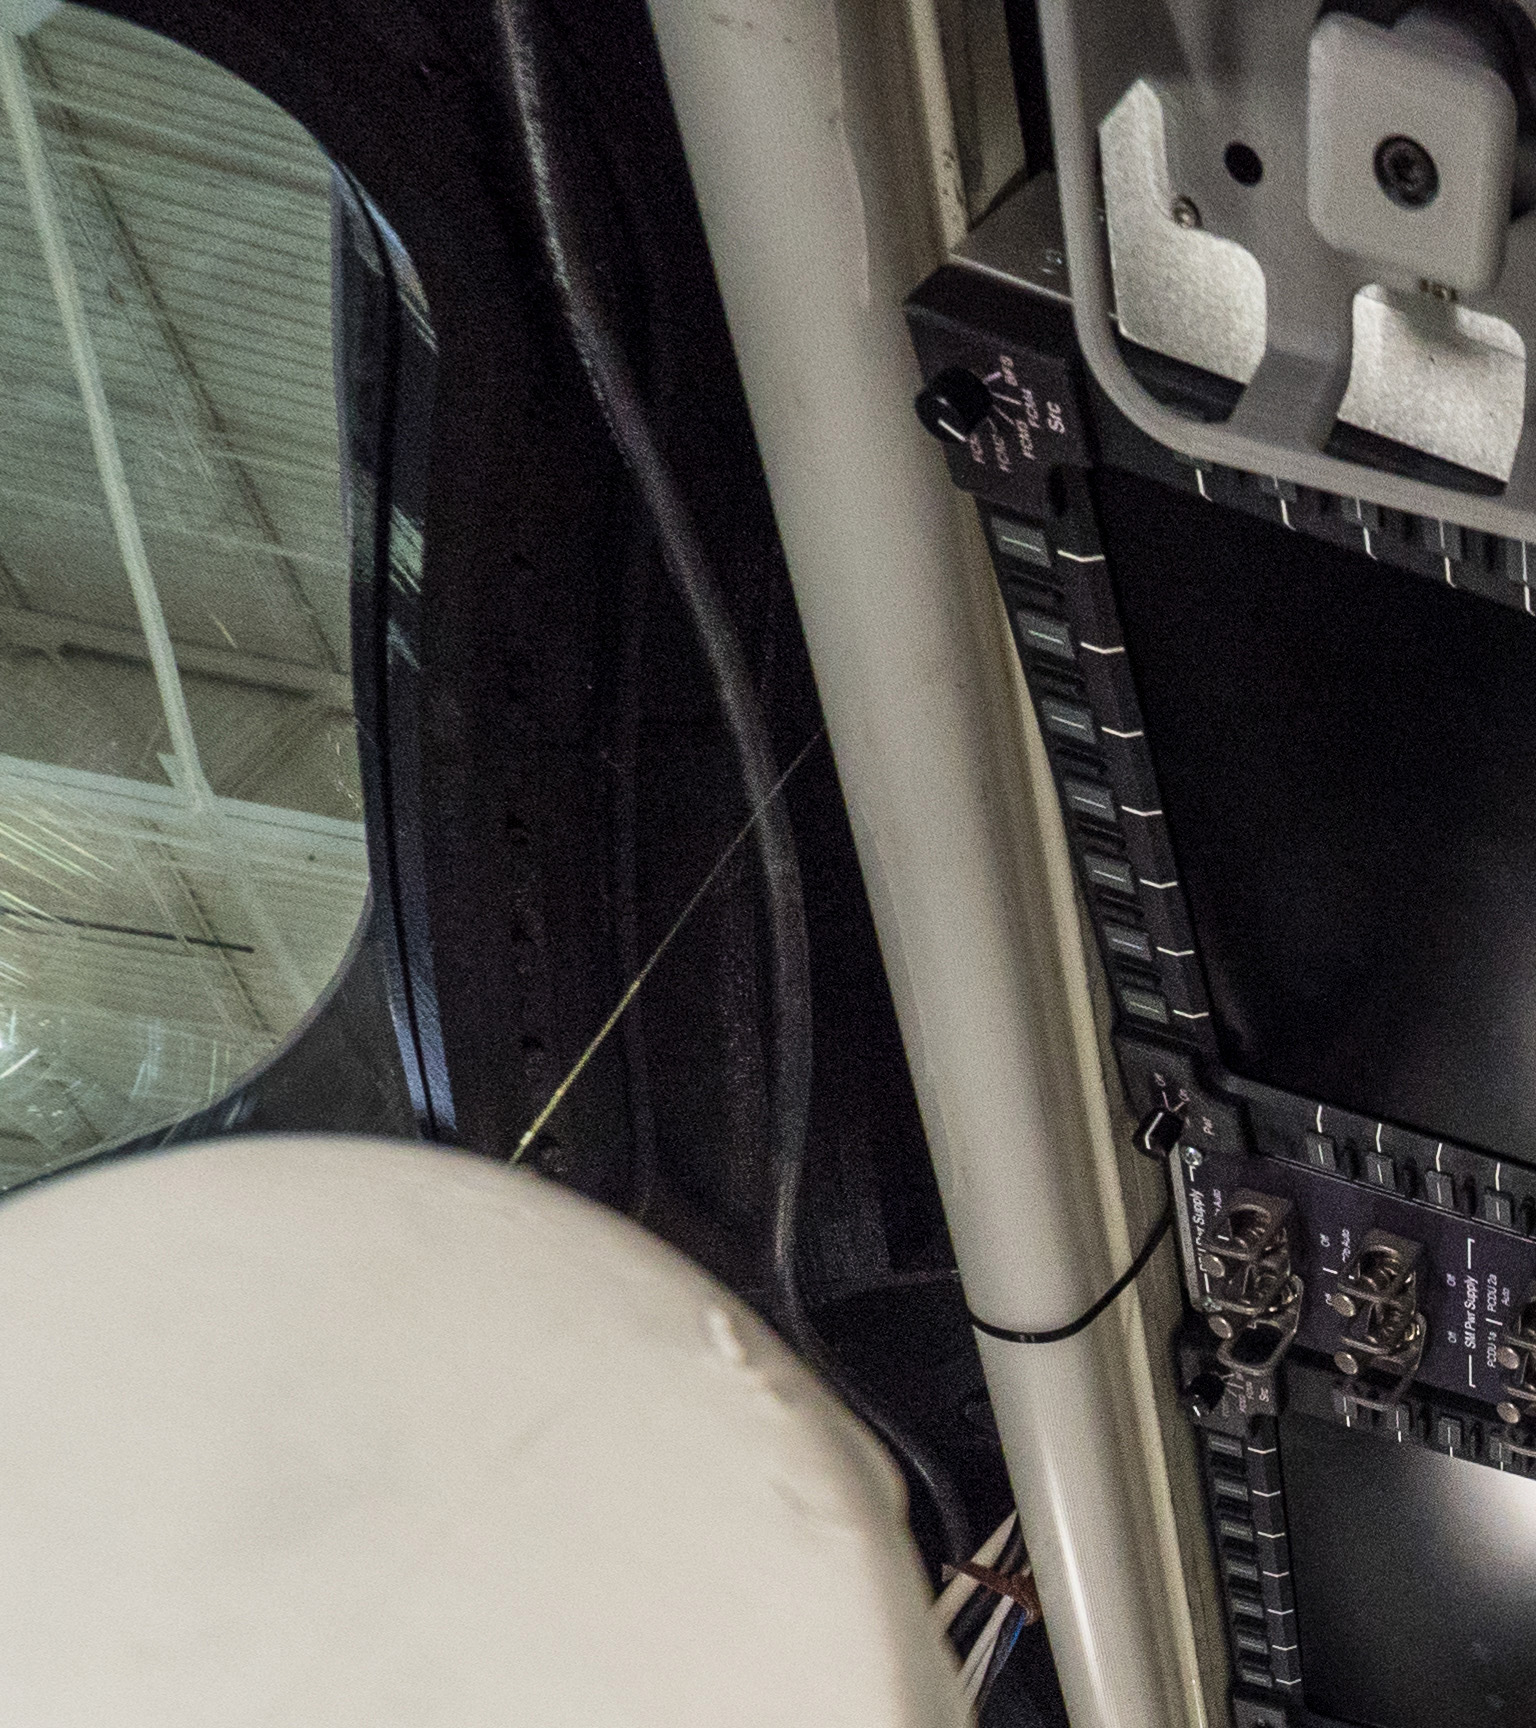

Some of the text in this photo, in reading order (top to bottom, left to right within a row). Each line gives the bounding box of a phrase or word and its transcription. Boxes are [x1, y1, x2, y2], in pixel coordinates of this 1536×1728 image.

[1047, 400, 1063, 433] Src
[1190, 1188, 1205, 1224] Supply
[1465, 1274, 1479, 1349] SM Pwr Supply
[1486, 1285, 1497, 1312] PCDU
[1485, 1342, 1498, 1368] PCDU
